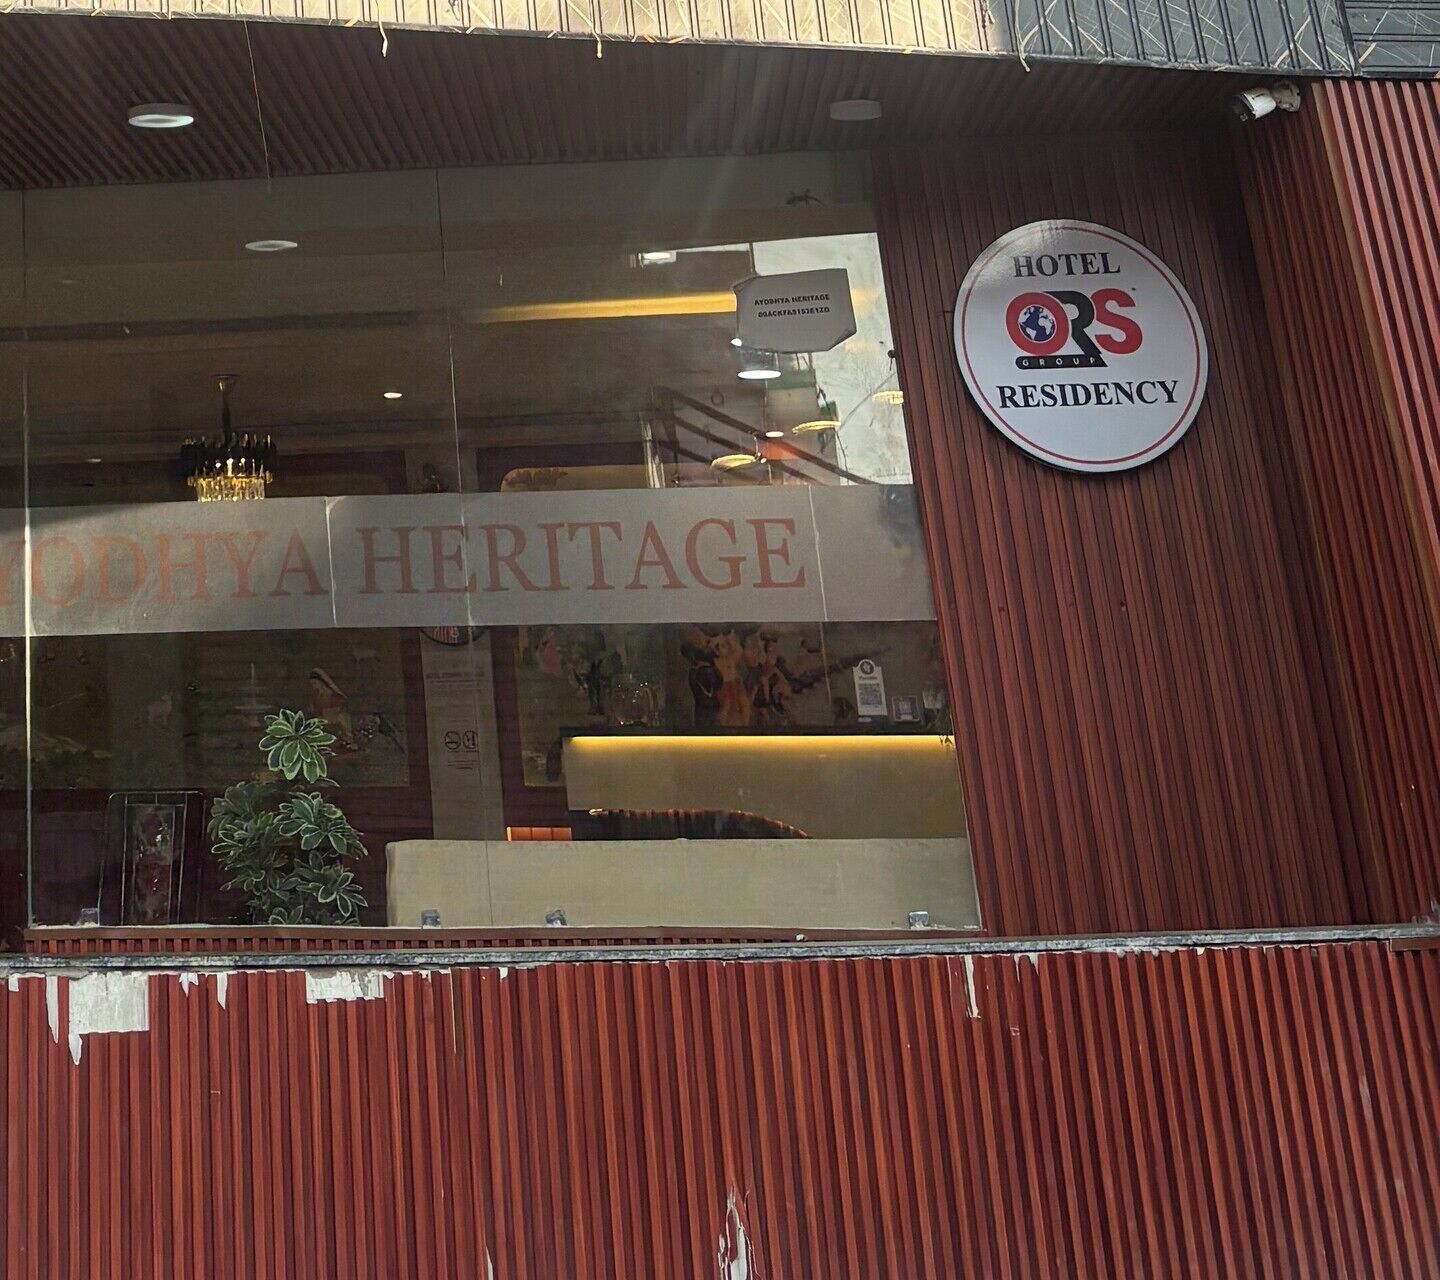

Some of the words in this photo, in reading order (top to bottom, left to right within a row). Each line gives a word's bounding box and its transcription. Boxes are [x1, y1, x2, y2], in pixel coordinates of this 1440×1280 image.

[1013, 252, 1120, 278] HOTEL
[1006, 287, 1143, 356] ORS
[1022, 356, 1096, 367] GROUP
[996, 380, 1179, 409] RESIDENCY
[357, 515, 808, 595] HERITAGE
